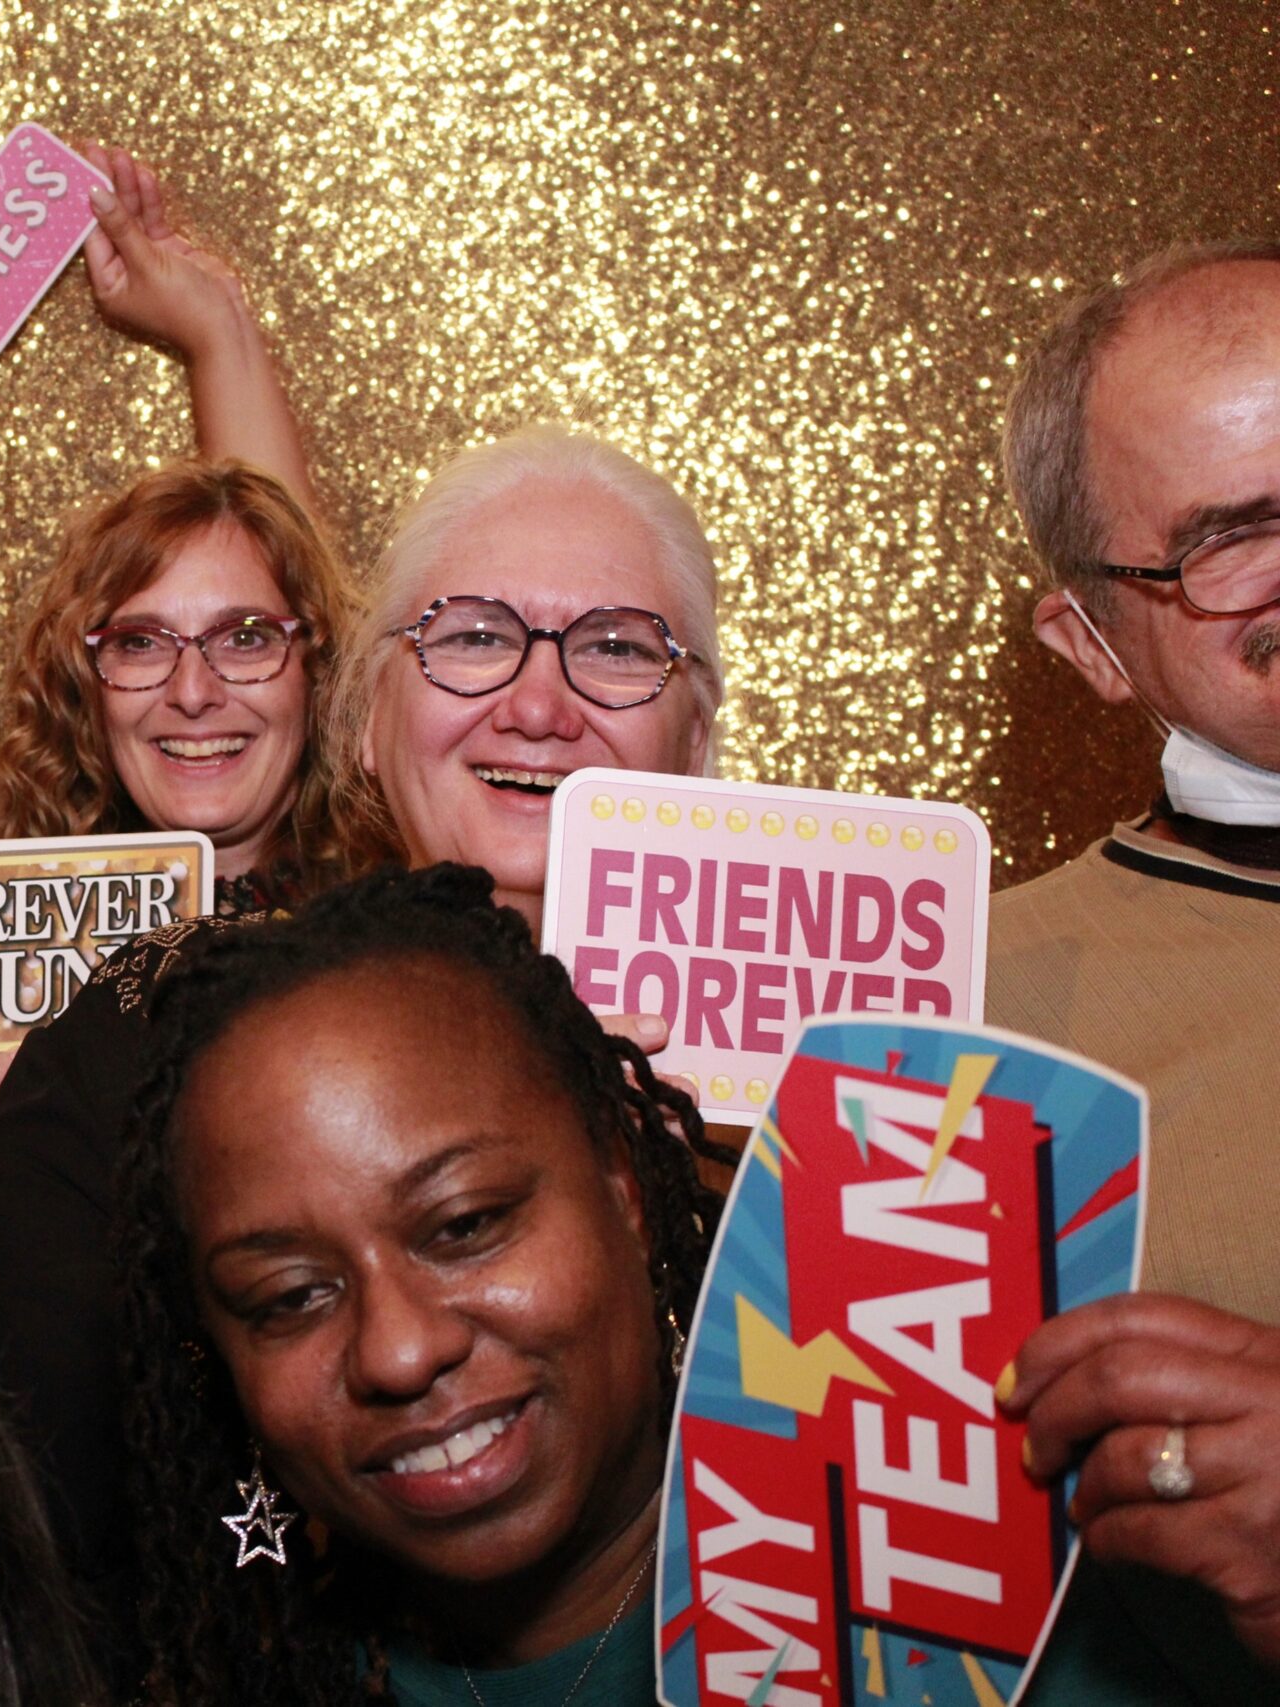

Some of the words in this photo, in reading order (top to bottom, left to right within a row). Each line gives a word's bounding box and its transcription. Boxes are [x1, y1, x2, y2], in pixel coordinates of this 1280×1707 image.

[585, 847, 947, 971] FRIENDS
[833, 1075, 1002, 1613] TEAM
[692, 1457, 823, 1707] MY
